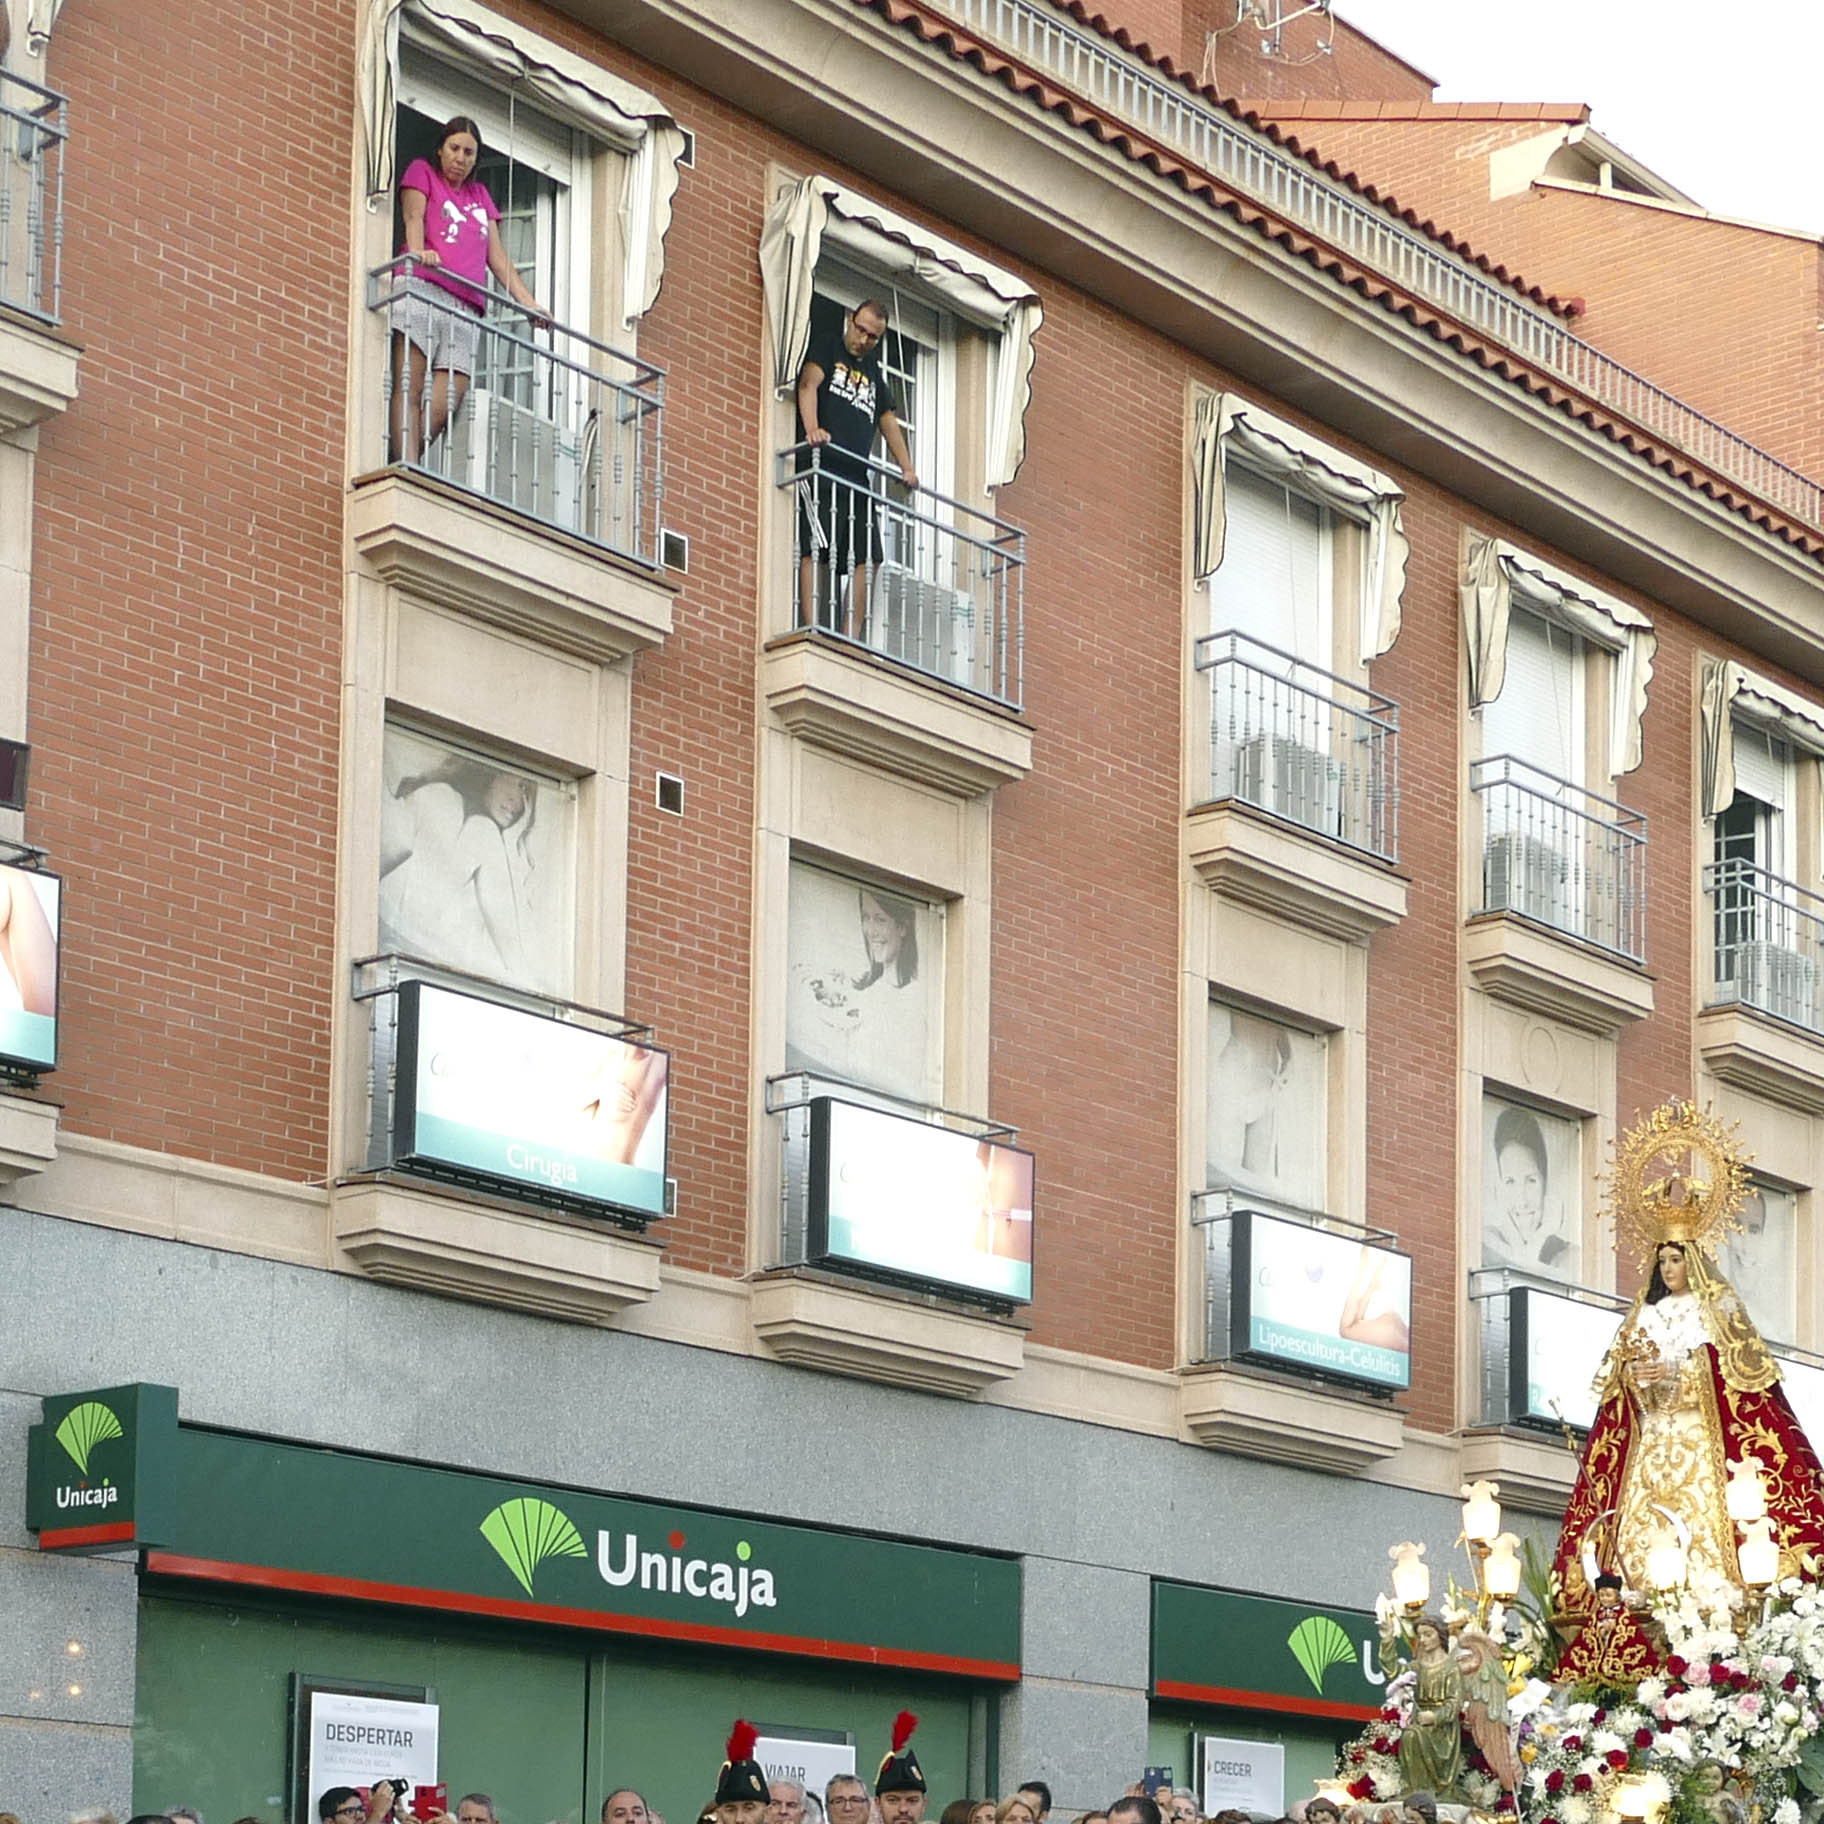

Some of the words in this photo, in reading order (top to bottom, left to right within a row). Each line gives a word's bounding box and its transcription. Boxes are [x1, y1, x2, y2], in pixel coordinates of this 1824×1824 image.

[505, 1143, 578, 1186] Cirugía
[1258, 1323, 1402, 1378] Lipoescultura-Celulitis
[56, 1477, 118, 1510] Unicaja
[597, 1529, 778, 1618] Unicaja
[325, 1723, 414, 1749] DESPERTAR
[764, 1763, 807, 1782] VIAJAR
[1213, 1760, 1253, 1778] CRECER
